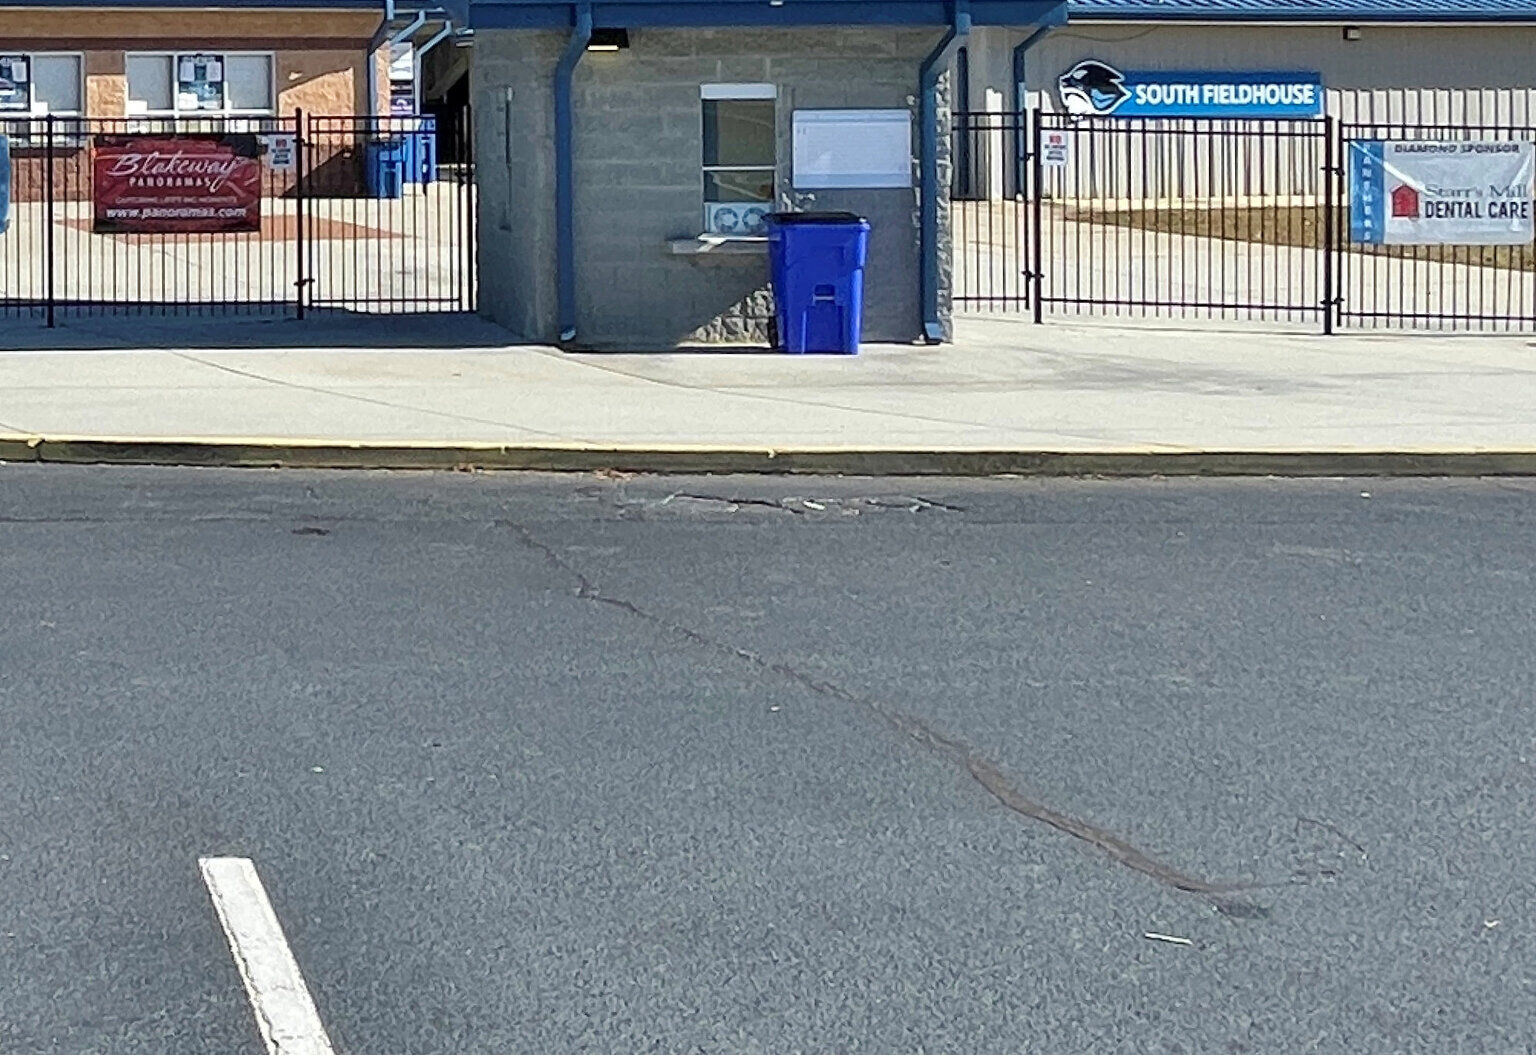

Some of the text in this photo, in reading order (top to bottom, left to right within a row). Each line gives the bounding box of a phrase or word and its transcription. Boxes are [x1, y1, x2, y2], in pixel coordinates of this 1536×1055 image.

[1135, 83, 1315, 105] SOUTH FIELDHOUSE
[1394, 144, 1520, 154] DIAMOND SPONSOR
[106, 150, 241, 193] Blakeway
[128, 176, 212, 188] PANORAMAS
[1489, 184, 1528, 198] Mill
[1425, 200, 1529, 219] DENTAL CARE
